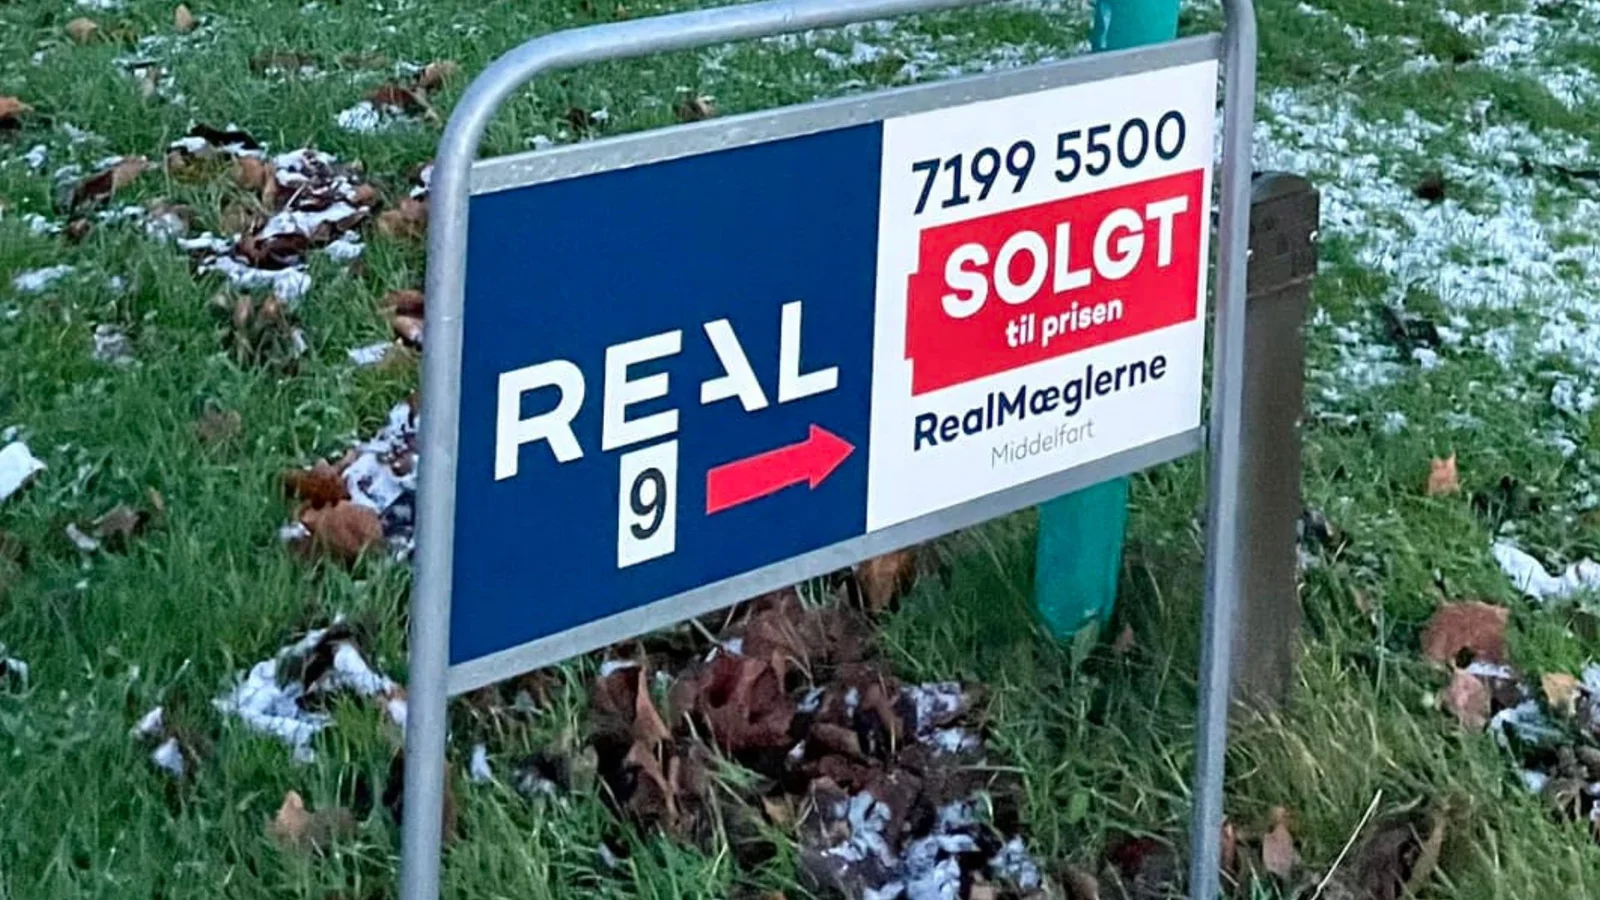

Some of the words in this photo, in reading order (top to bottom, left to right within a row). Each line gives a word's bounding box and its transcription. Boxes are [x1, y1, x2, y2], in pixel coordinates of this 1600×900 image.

[912, 140, 1036, 215] 7199
[1055, 110, 1186, 183] 5500
[941, 195, 1188, 319] SOLGT
[1006, 314, 1035, 347] til
[1041, 299, 1123, 347] prisen
[495, 300, 839, 481] REAL
[913, 354, 1167, 451] RealMæglerne
[990, 420, 1096, 469] Middelfart
[629, 467, 667, 540] 9
